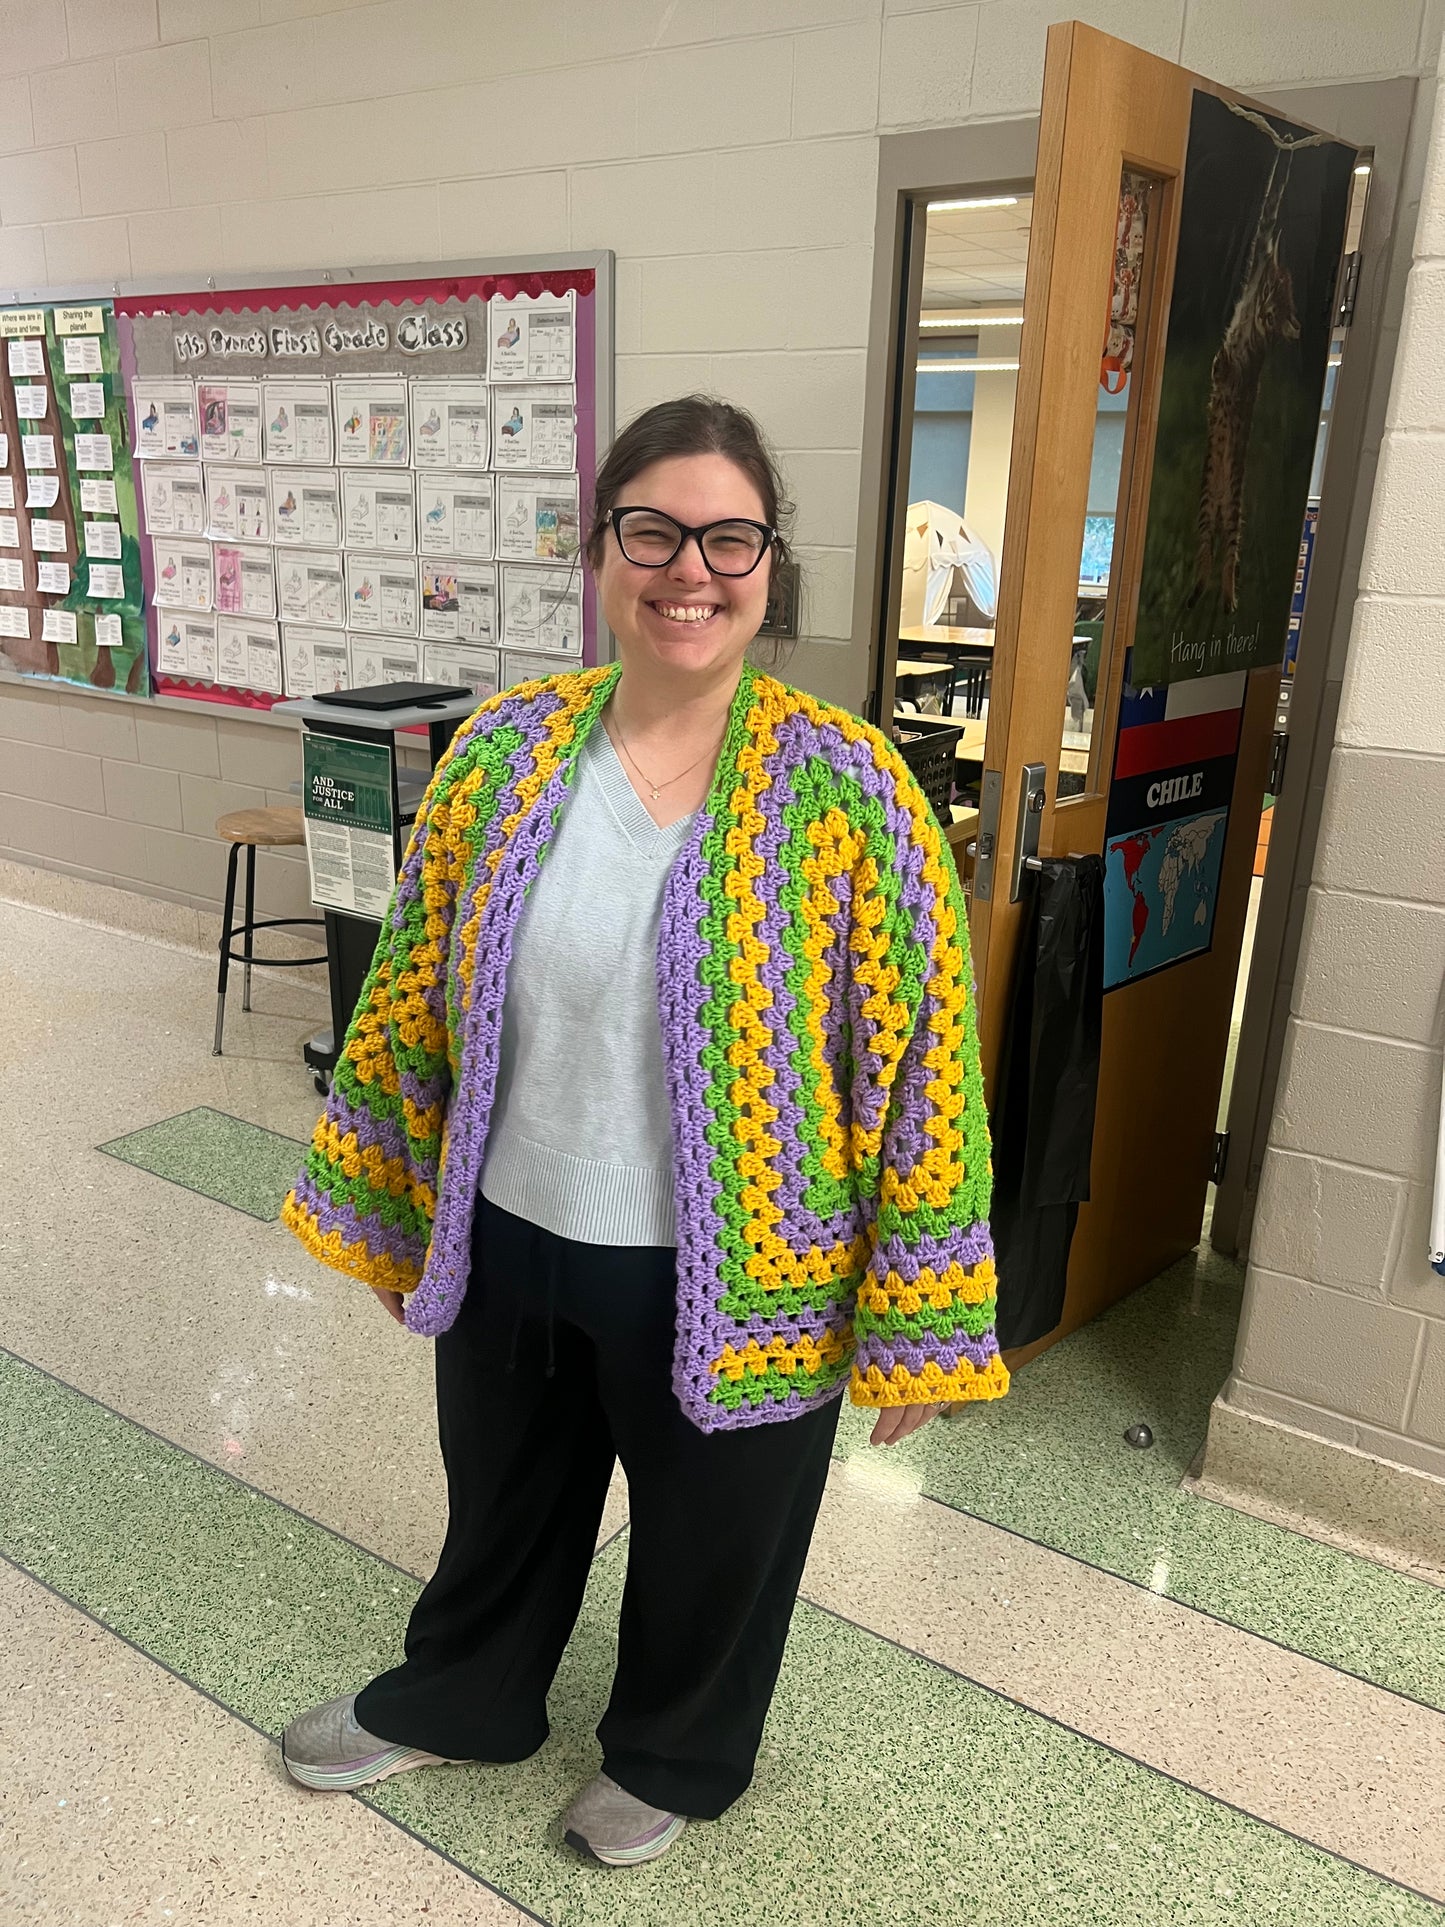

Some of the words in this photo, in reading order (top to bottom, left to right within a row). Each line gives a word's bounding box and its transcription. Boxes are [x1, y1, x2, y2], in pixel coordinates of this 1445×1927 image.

[2, 313, 17, 322] Where
[37, 312, 42, 320] in
[62, 310, 83, 320] Sharing
[84, 310, 93, 318] the
[5, 325, 18, 335] place
[19, 325, 28, 333] and
[29, 324, 40, 332] time
[70, 323, 87, 332] planet
[176, 333, 204, 357] Ms.
[271, 328, 318, 353] First
[324, 320, 386, 351] Grade
[397, 316, 464, 350] Class
[1171, 631, 1206, 673] Hang
[1210, 634, 1221, 657] in
[1226, 621, 1260, 655] there!
[312, 775, 335, 787] AND
[312, 785, 355, 801] JUSTICE
[1146, 771, 1204, 808] CHILE
[324, 798, 344, 810] ALL
